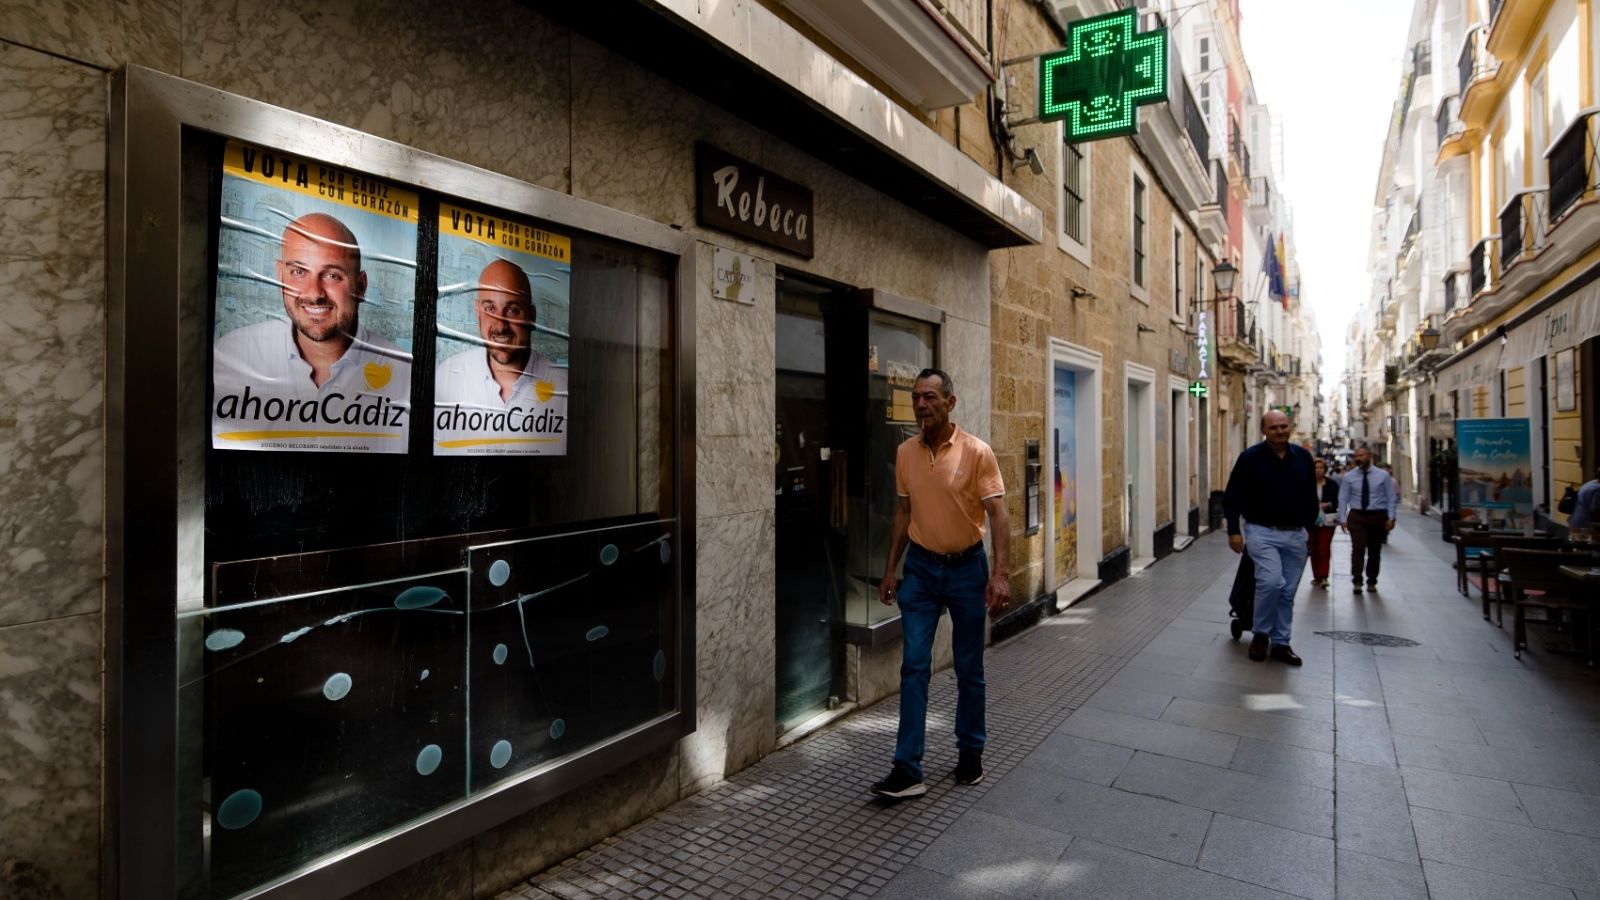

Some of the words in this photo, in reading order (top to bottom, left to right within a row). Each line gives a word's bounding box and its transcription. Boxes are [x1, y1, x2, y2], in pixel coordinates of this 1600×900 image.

[242, 146, 309, 189] VOTA
[319, 167, 345, 186] POR
[318, 182, 344, 201] CON
[352, 191, 408, 218] CORAZÓN
[712, 165, 808, 241] Rebeca
[451, 208, 496, 240] VOTA
[502, 221, 519, 235] POR
[502, 233, 519, 248] CON
[525, 240, 564, 259] CORAZÓN
[1198, 312, 1208, 378] FARMACIA
[216, 386, 407, 427] ahoraCádiz
[436, 403, 565, 434] ahoraCádiz
